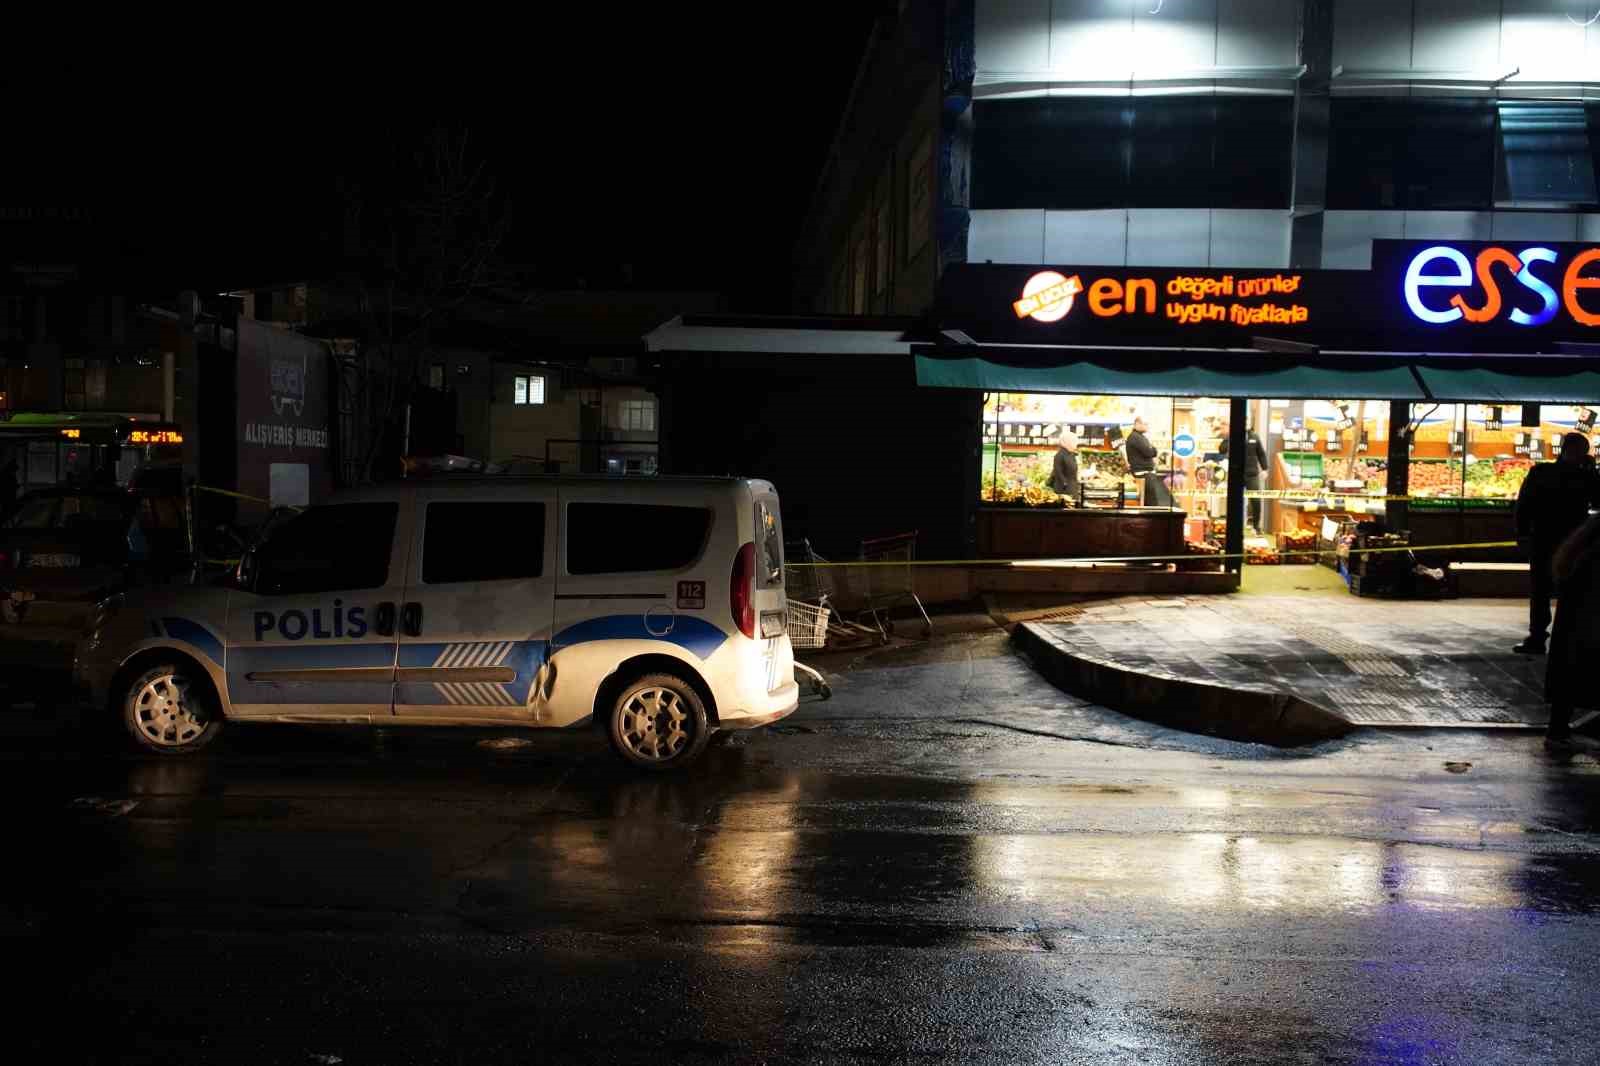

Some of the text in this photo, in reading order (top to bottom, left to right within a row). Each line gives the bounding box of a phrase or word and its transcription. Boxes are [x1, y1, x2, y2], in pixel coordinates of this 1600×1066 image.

[1088, 277, 1156, 317] en
[1167, 275, 1233, 300] değerli
[1166, 302, 1309, 325] uygun fiyatlarla
[681, 583, 701, 597] 112
[253, 598, 367, 641] POLİS
